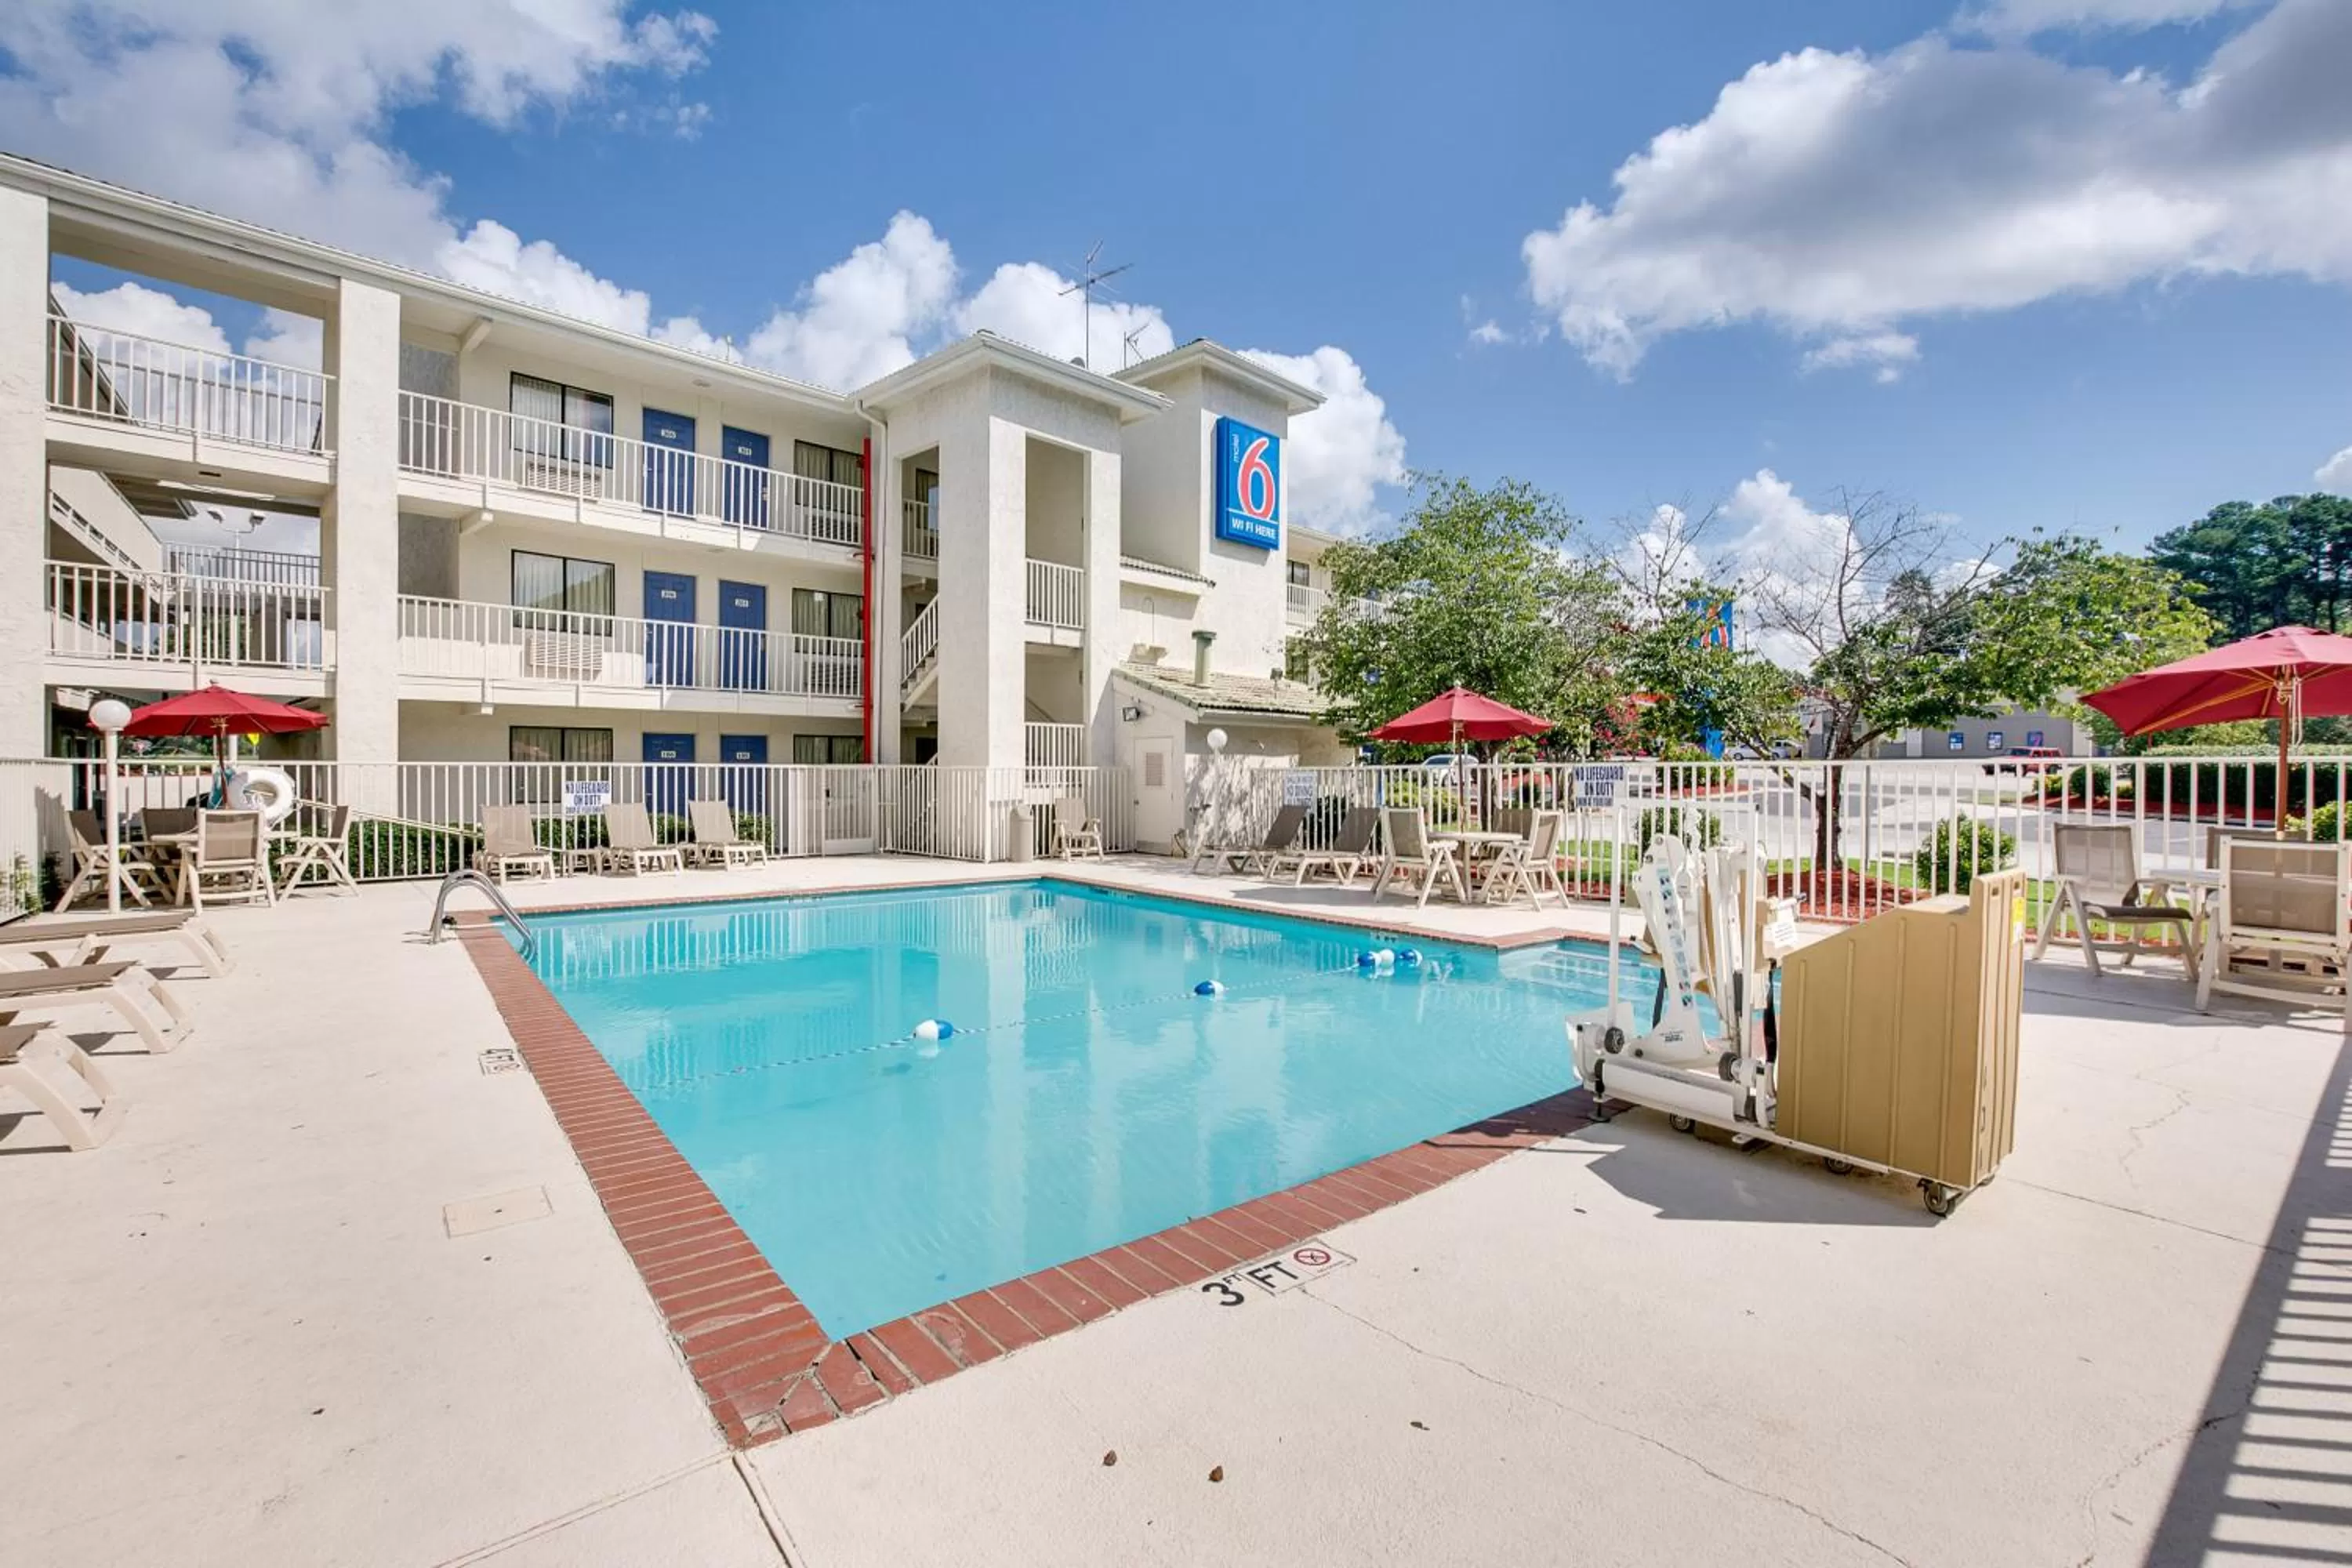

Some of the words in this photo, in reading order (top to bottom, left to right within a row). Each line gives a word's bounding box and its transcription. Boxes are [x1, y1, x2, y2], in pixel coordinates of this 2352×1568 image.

[1237, 437, 1276, 521] 6
[1232, 517, 1244, 531] WI
[1246, 520, 1254, 534] FI
[1254, 523, 1276, 539] HERE
[1575, 767, 1584, 782] NO
[1586, 765, 1623, 781] LIFEGUARD
[1584, 782, 1595, 796] ON
[1595, 782, 1614, 796] DUTY
[1201, 1281, 1245, 1307] 3
[1247, 1260, 1299, 1289] FT
[1222, 1273, 1242, 1285] FT
